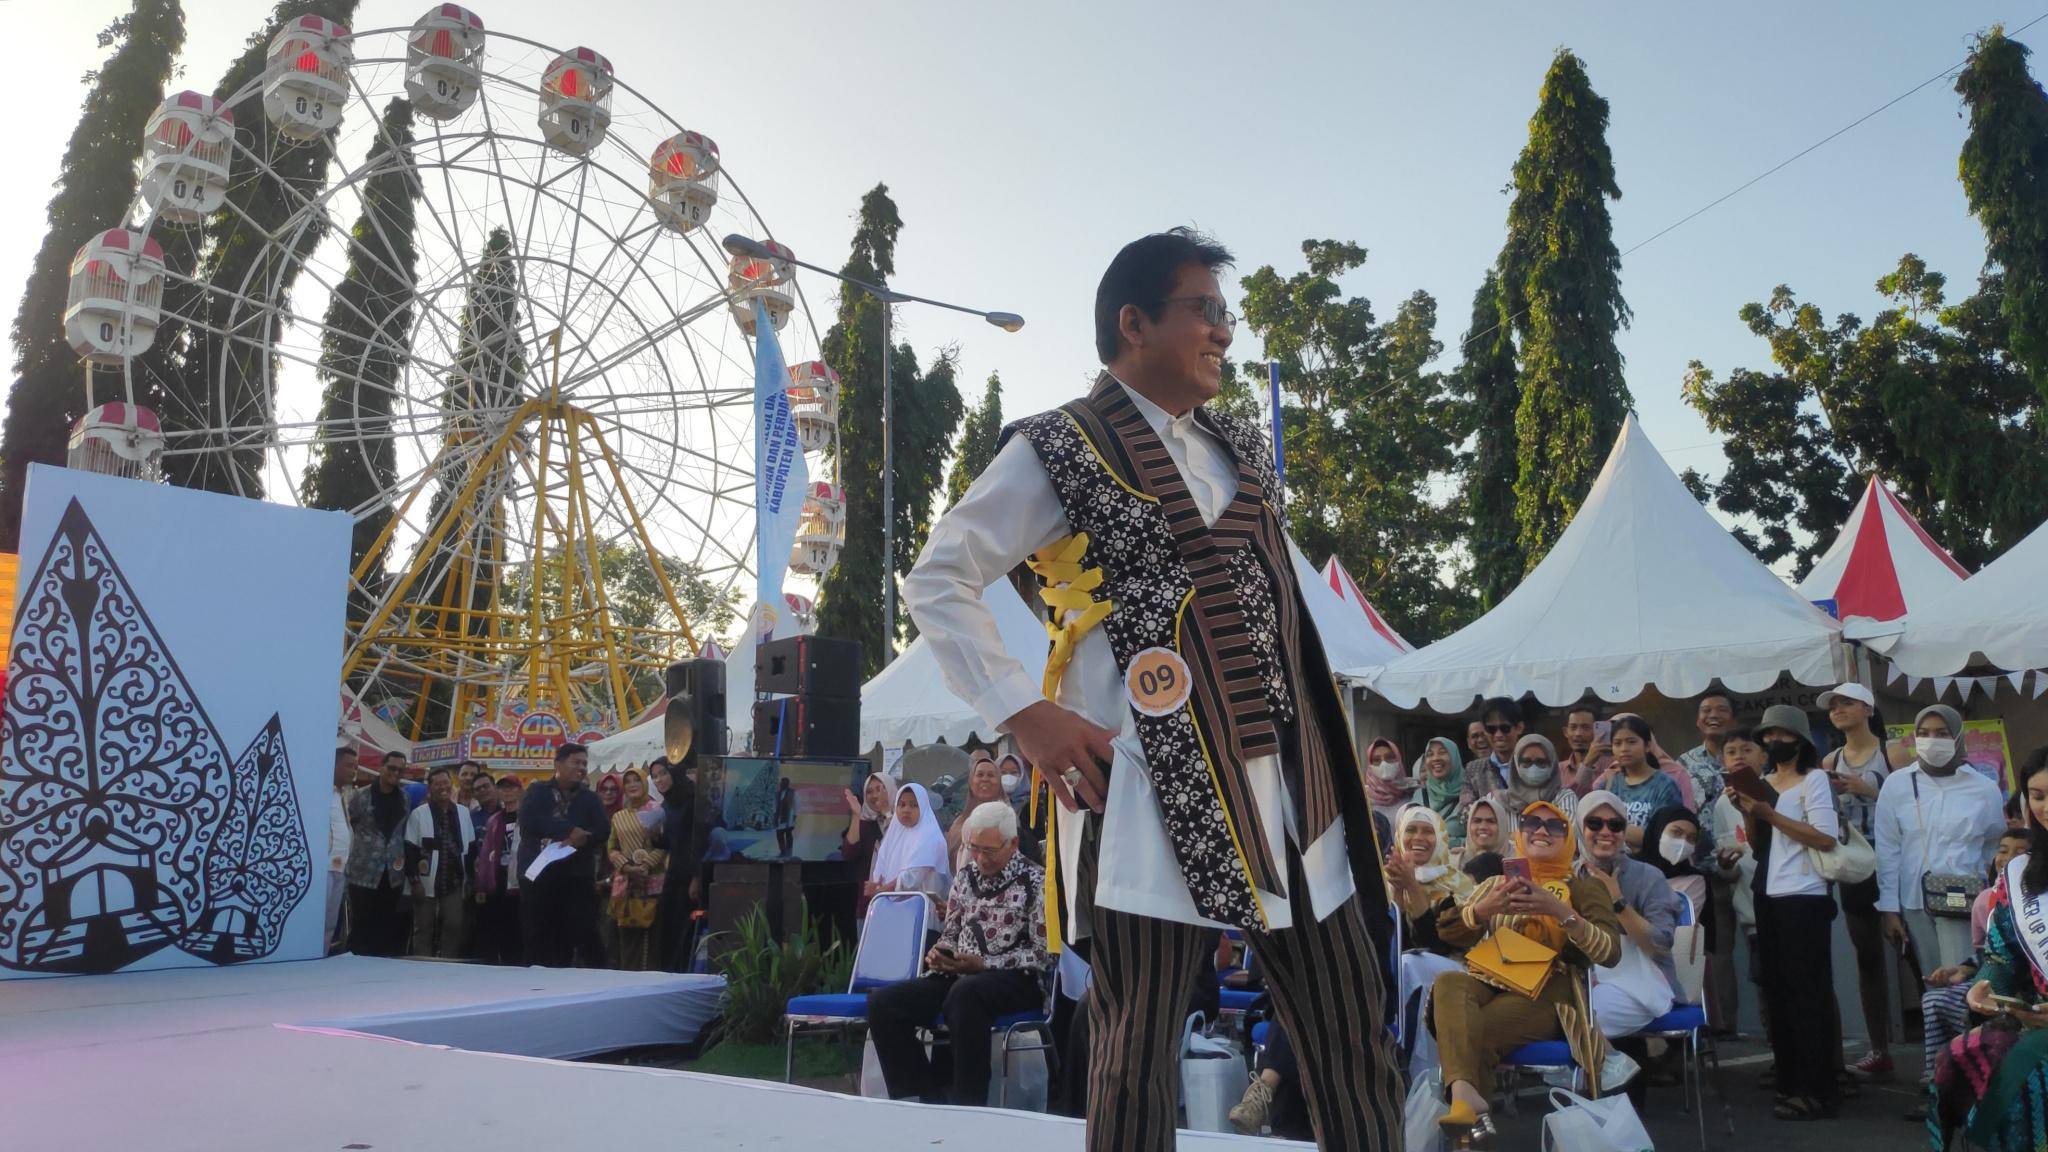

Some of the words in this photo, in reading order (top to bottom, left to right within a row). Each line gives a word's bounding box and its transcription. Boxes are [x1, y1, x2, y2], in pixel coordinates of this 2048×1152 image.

[437, 79, 461, 101] 02
[295, 96, 323, 121] 03
[173, 179, 205, 205] 04
[680, 201, 700, 221] 16
[767, 440, 782, 464] DAN
[769, 449, 794, 514] KABUPATEN
[812, 550, 827, 564] 13
[1139, 664, 1175, 696] 09
[440, 744, 456, 759] BOX
[471, 735, 557, 759] Berkah
[2028, 919, 2046, 934] UP
